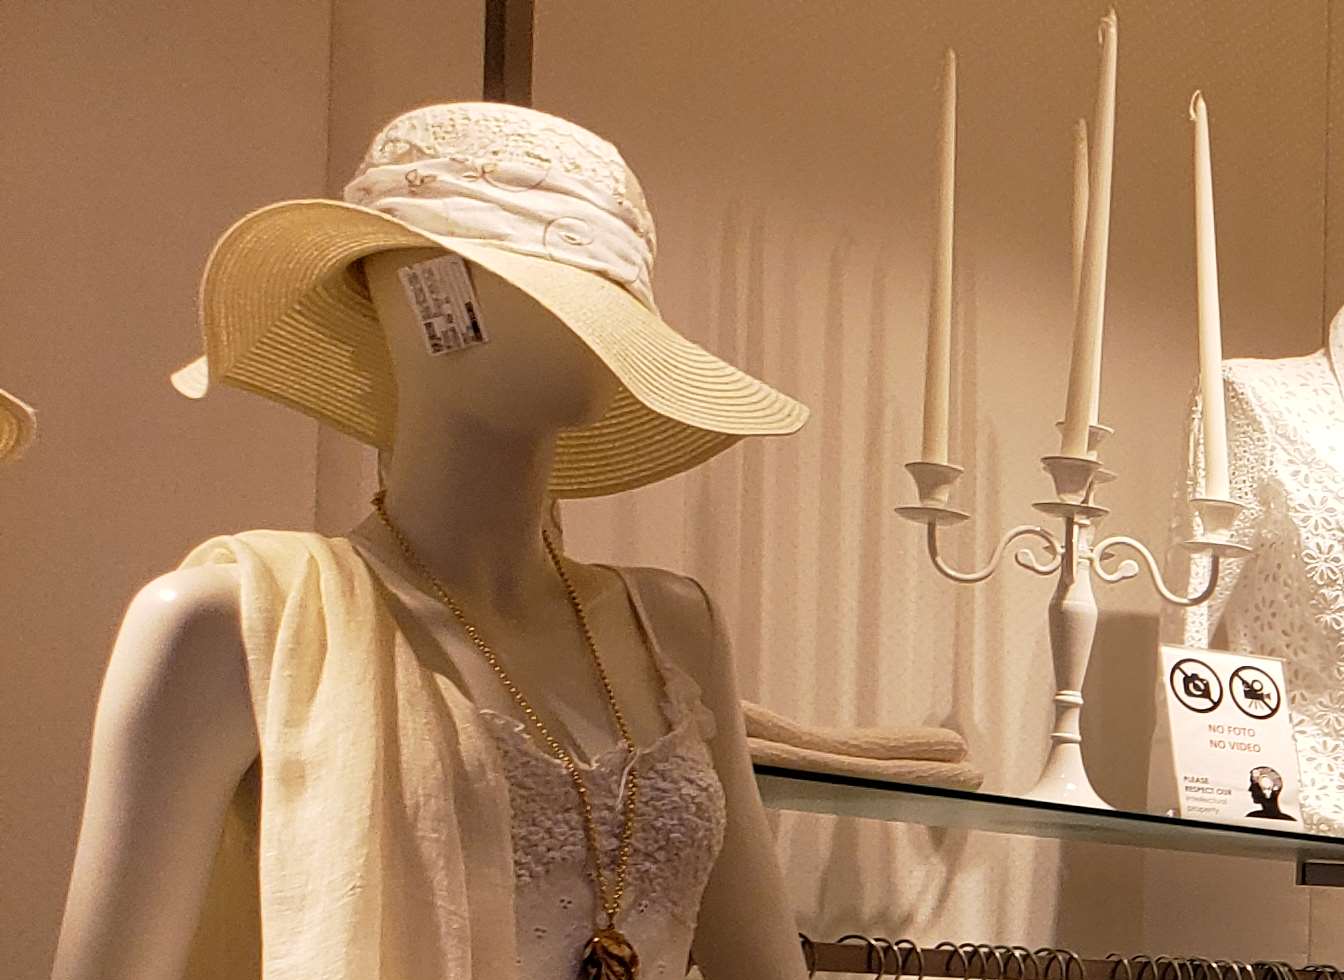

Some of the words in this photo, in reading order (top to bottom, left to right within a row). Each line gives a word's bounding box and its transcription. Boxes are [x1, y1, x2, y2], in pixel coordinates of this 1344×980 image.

[1208, 724, 1224, 734] NO
[1227, 726, 1256, 737] FOTO
[1210, 739, 1226, 749] NO
[1228, 741, 1261, 753] VIDEO
